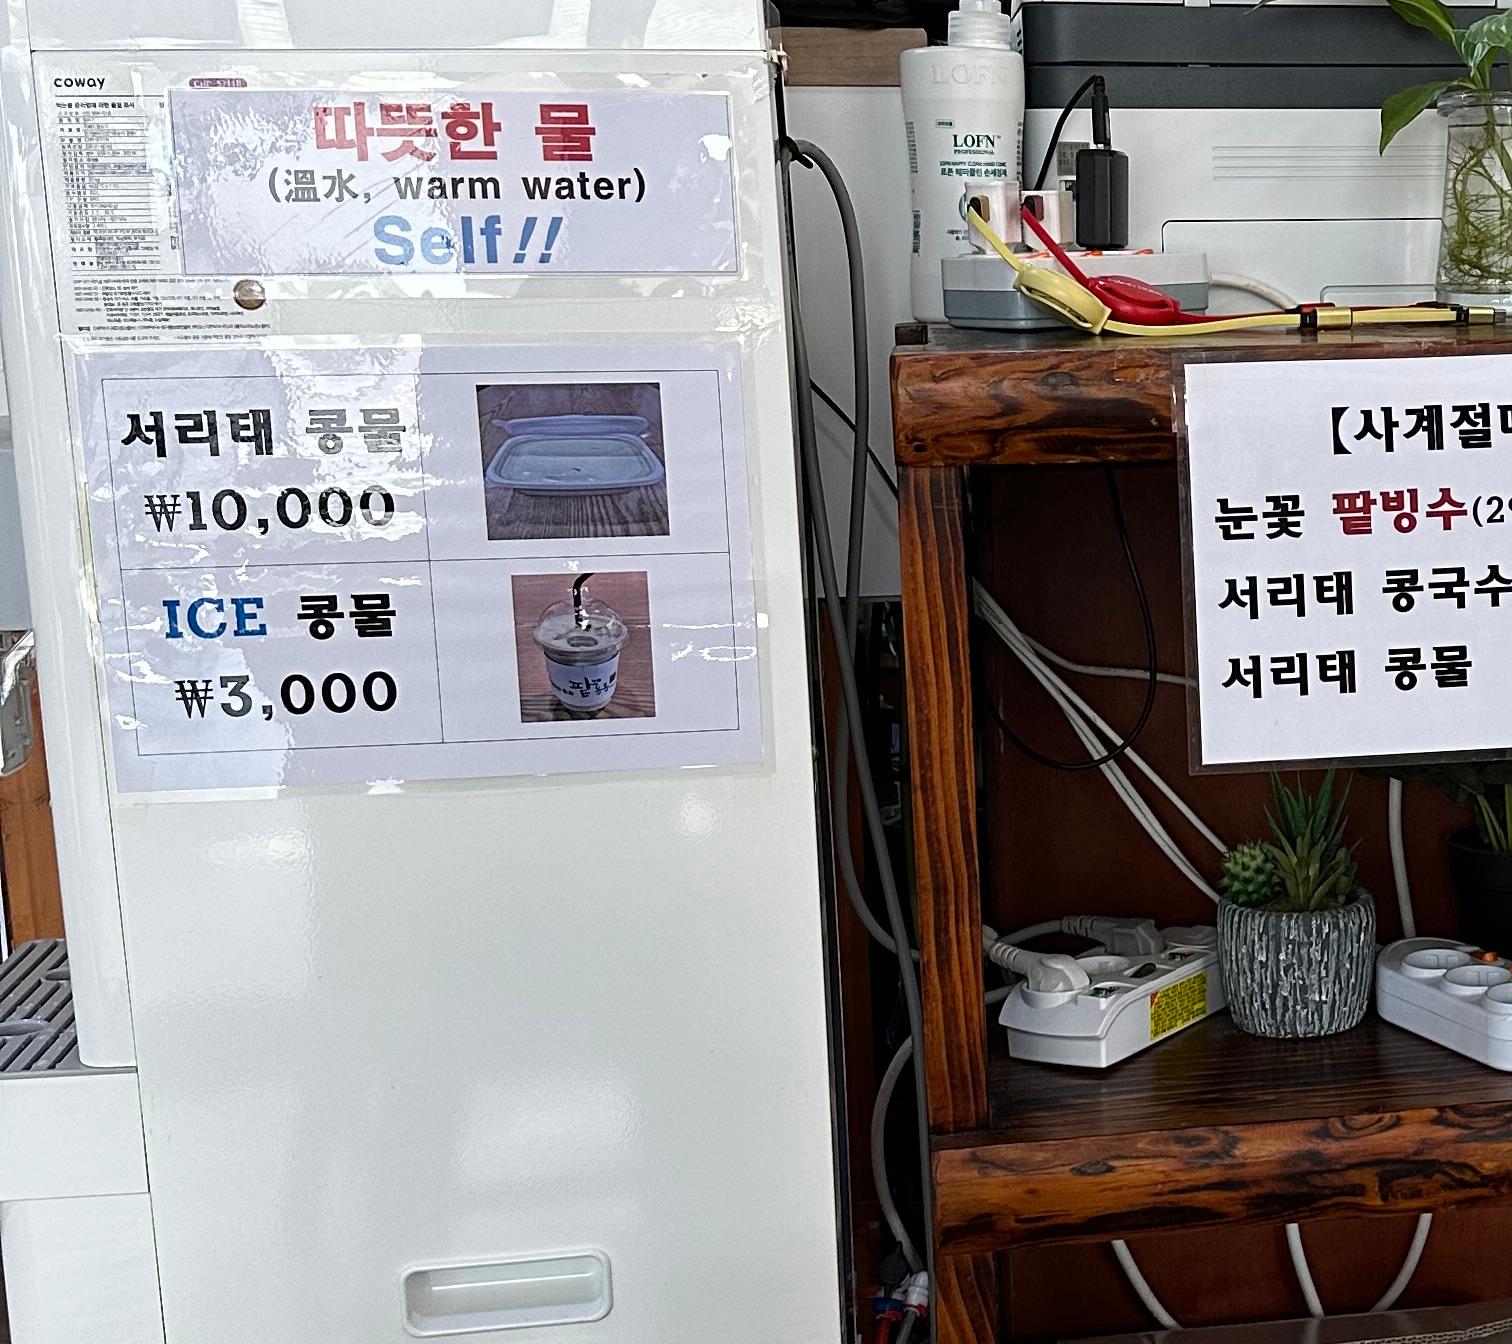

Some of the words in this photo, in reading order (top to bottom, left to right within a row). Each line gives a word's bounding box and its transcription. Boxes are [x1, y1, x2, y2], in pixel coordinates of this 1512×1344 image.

[53, 77, 106, 90] coway
[313, 101, 503, 163] 따뜻한
[535, 101, 597, 161] 물
[953, 134, 996, 148] LOFN
[394, 175, 501, 202] warm
[521, 167, 647, 204] water)
[373, 214, 565, 266] Self!!
[120, 410, 276, 459] 서리태
[304, 408, 408, 457] 콩물
[143, 485, 396, 536] ₩10,000
[1214, 493, 1306, 542] 눈꽃
[162, 596, 269, 640] ICE
[296, 593, 398, 640] 콩물
[1218, 570, 1355, 620] 서리태
[174, 670, 399, 722] ₩3,000
[1221, 649, 1358, 699] 서리태
[1384, 644, 1474, 692] 콩물
